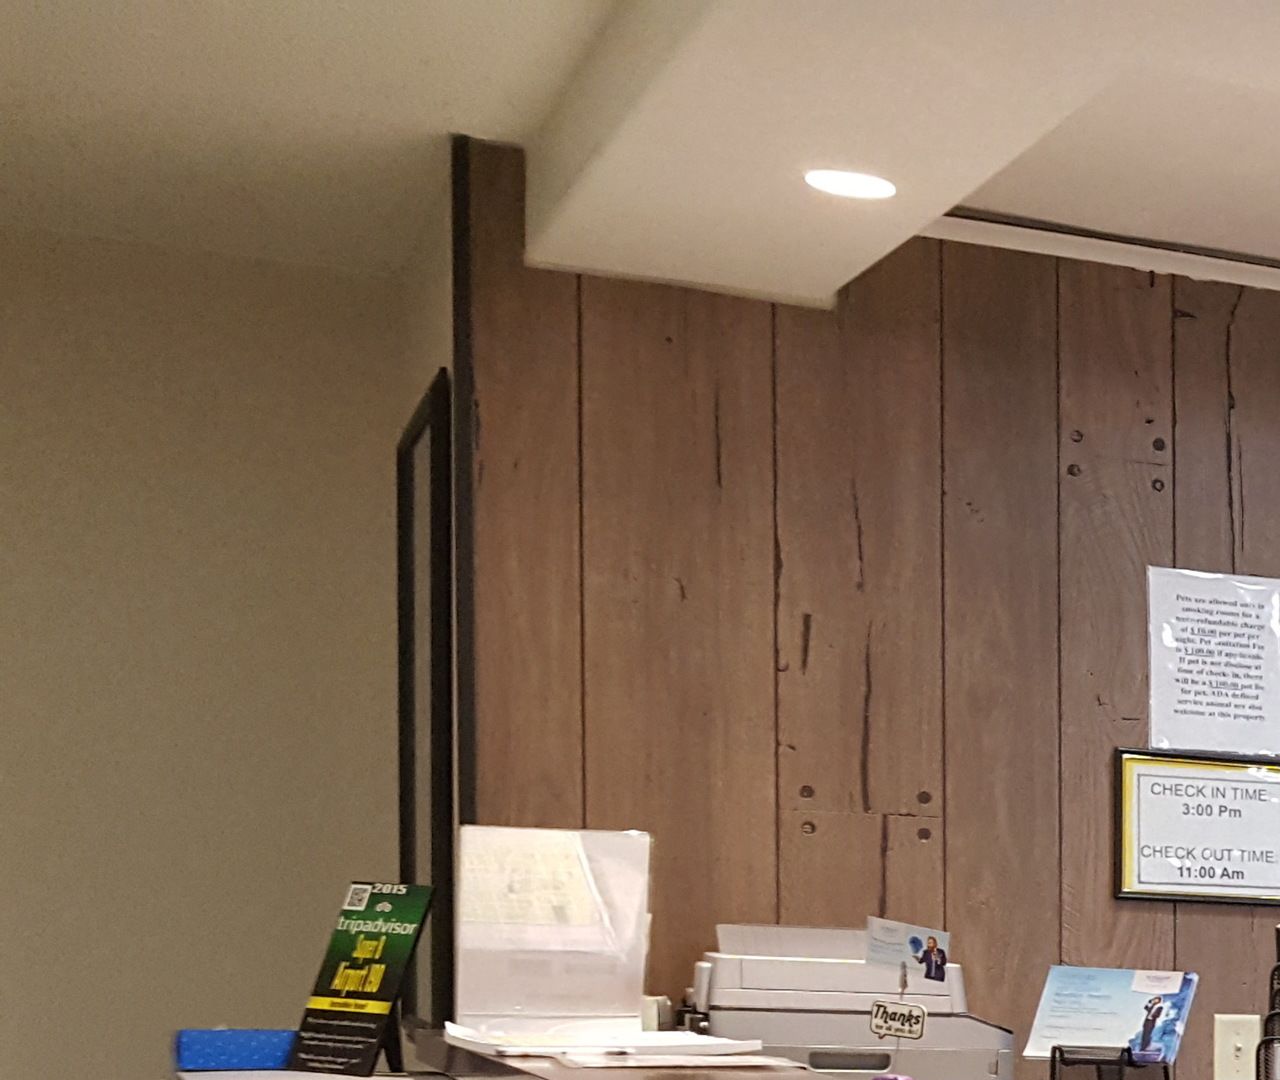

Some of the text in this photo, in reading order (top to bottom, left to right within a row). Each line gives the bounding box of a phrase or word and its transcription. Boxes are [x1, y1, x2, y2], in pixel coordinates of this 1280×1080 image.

[1150, 782, 1206, 798] CHECK
[1211, 786, 1226, 799] IN
[1182, 803, 1242, 818] 3:00 Pm
[1140, 844, 1196, 860] CHECK
[1201, 848, 1233, 861] OUT
[1177, 865, 1244, 880] 11:00 Am
[372, 883, 408, 895] 2015
[336, 916, 418, 935] tripadvisor
[874, 1003, 921, 1027] Thanks
